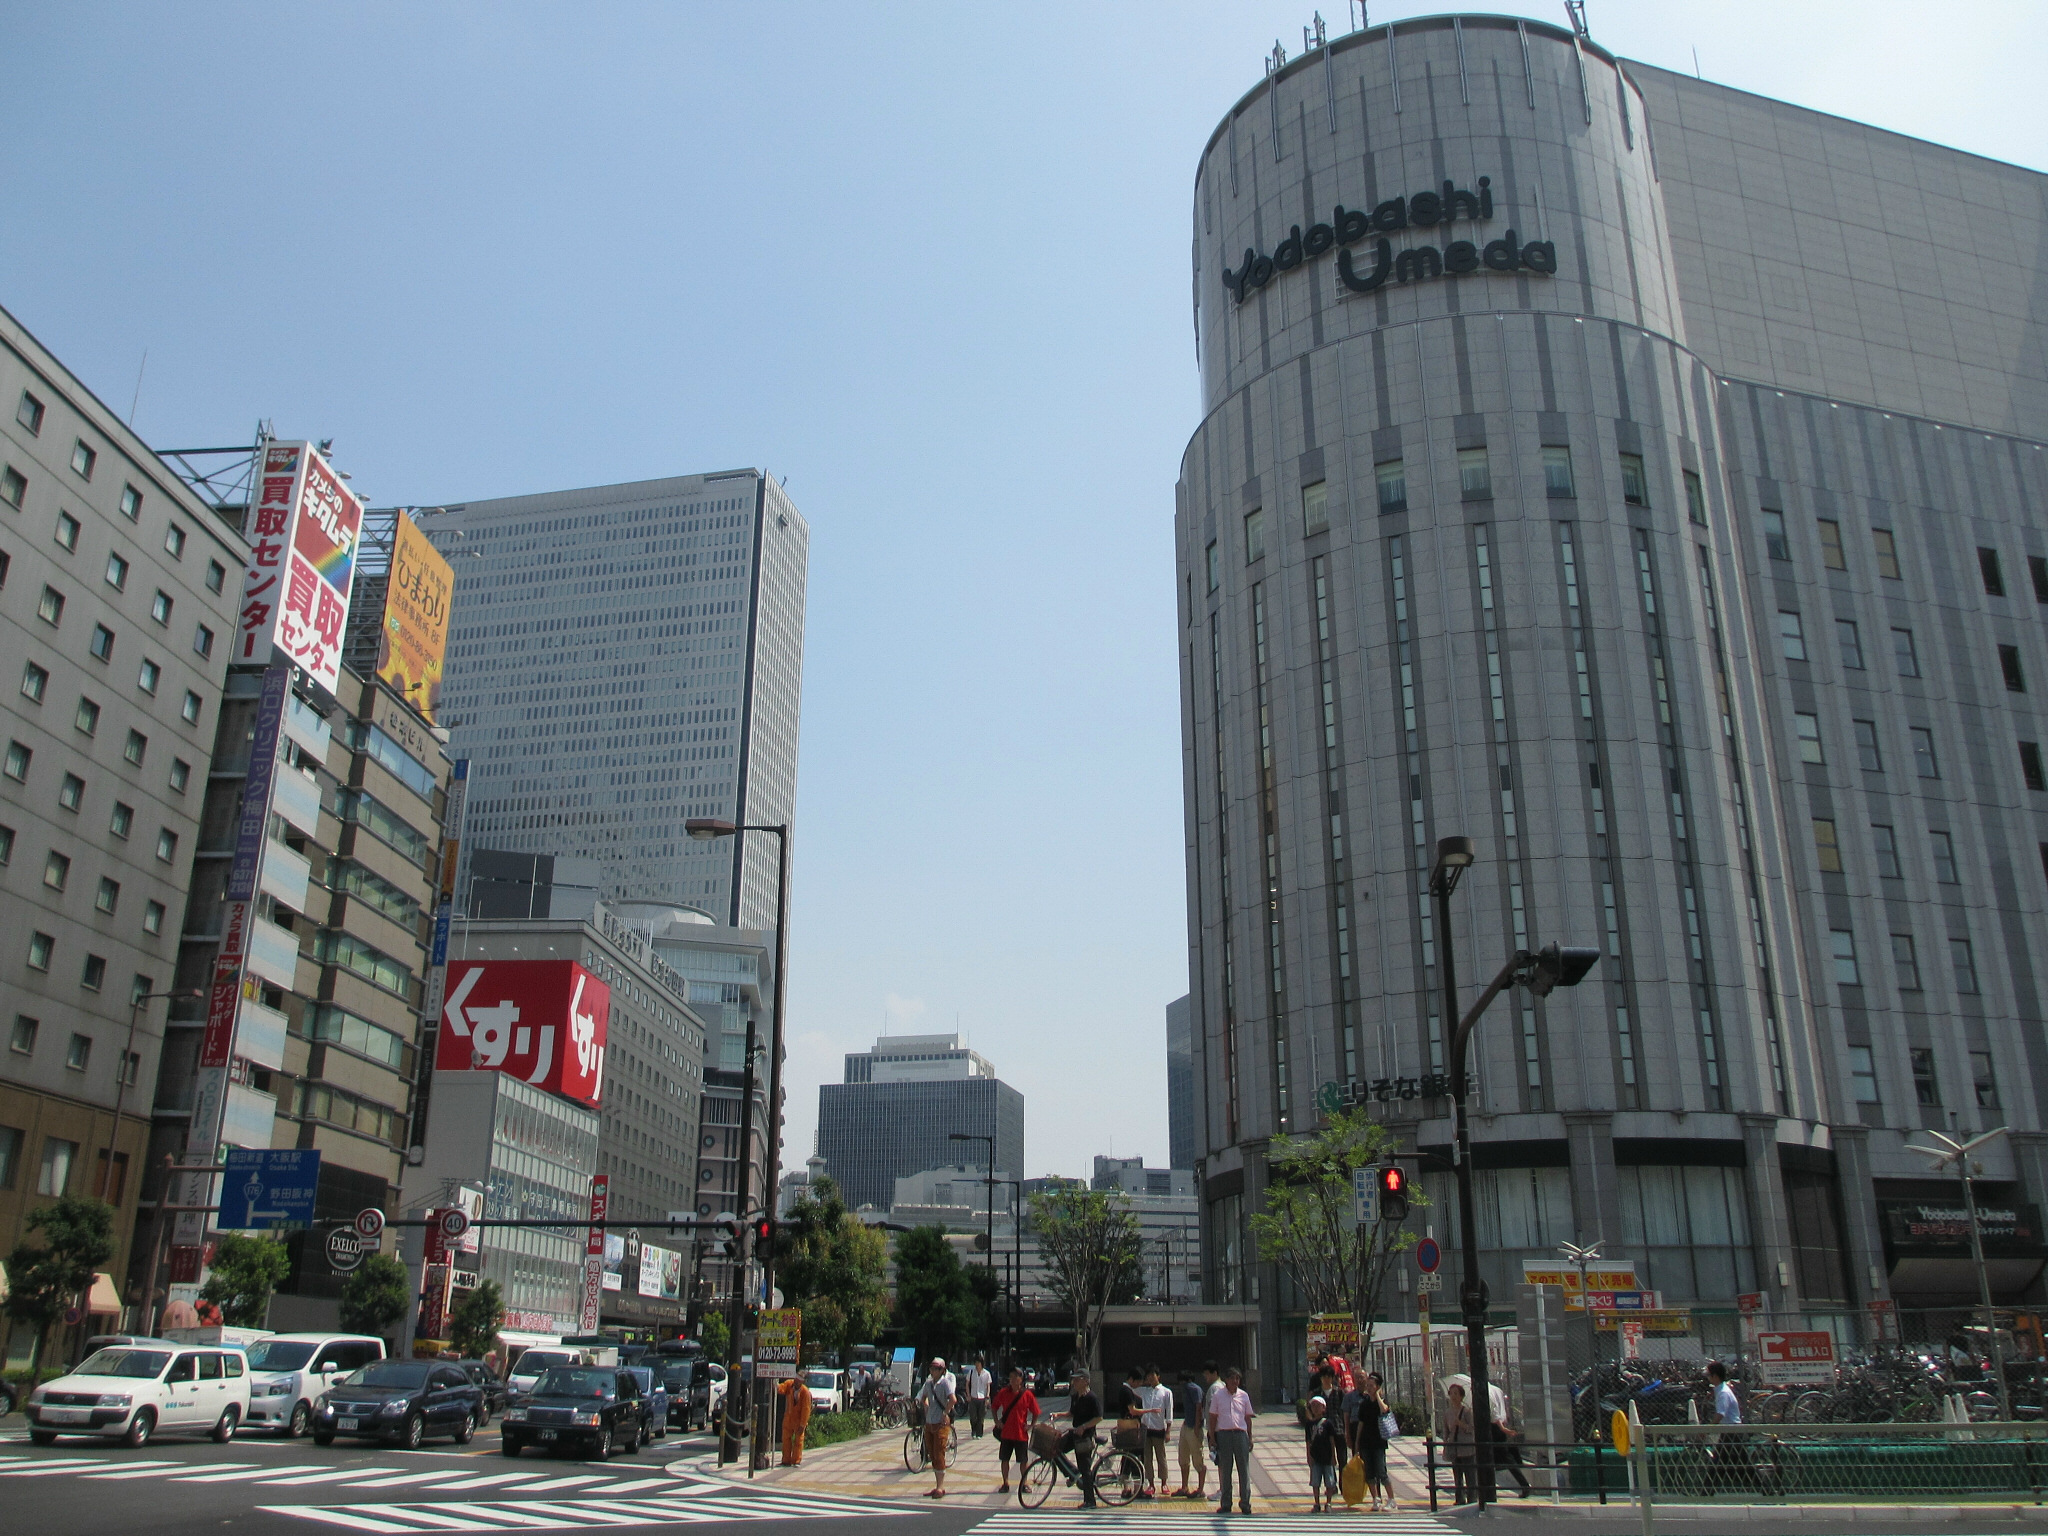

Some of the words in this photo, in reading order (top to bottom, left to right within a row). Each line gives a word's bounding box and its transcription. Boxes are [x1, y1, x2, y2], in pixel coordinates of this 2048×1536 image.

[1222, 176, 1493, 304] Yodobashi
[1338, 229, 1557, 292] Umeda
[303, 486, 354, 556] キタムラ
[308, 468, 343, 513] カメラの
[241, 477, 294, 657] 買取センター
[398, 560, 445, 627] ひまわり
[285, 559, 345, 652] 買取
[394, 588, 430, 637] 法律事務所
[281, 617, 336, 677] センター
[241, 677, 284, 836] 浜口クリニック梅田
[444, 967, 555, 1083] くすり
[570, 974, 604, 1100] くすり
[269, 1152, 302, 1163] 大阪駅
[247, 1186, 261, 1195] 176
[270, 1188, 314, 1199] 野田阪神
[331, 1236, 361, 1254] EXELCO
[446, 1218, 461, 1230] 40
[583, 1260, 601, 1330] 処方せん受付
